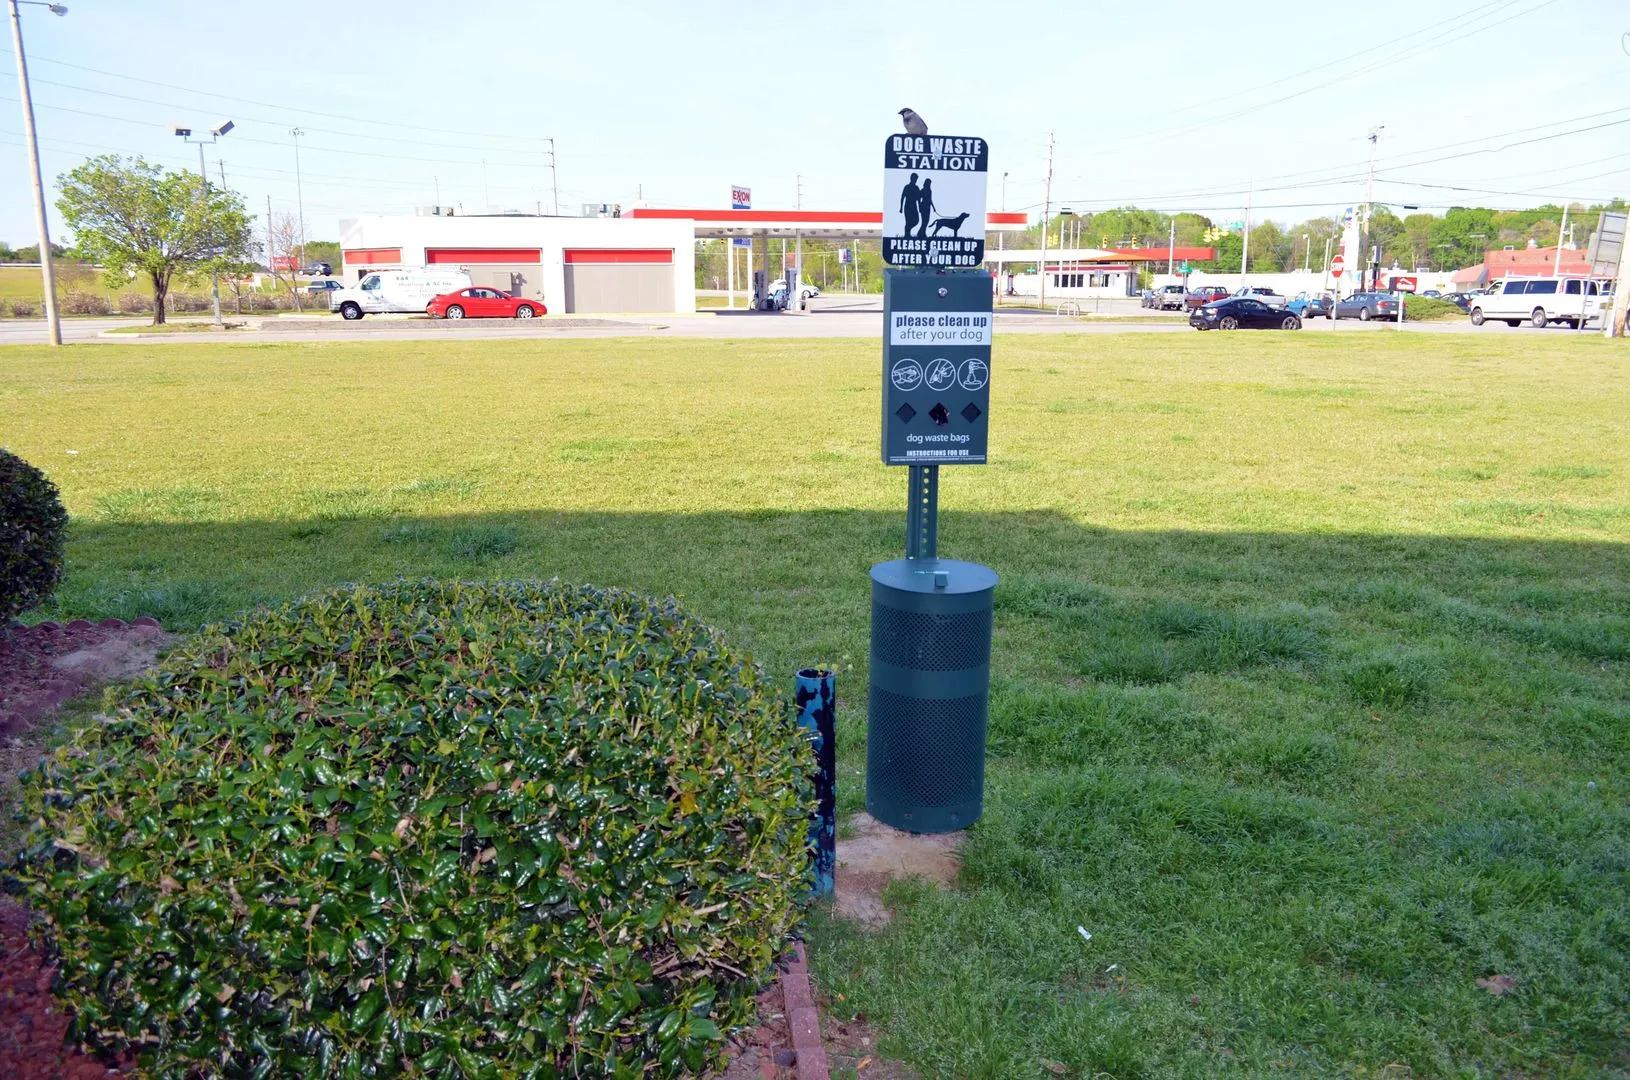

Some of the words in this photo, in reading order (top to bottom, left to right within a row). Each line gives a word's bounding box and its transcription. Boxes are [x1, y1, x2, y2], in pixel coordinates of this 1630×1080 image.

[893, 136, 924, 153] DOG
[929, 138, 982, 155] WASTE
[898, 155, 976, 171] STATION
[732, 190, 750, 204] EXXON
[890, 239, 927, 251] PLEASE
[929, 240, 961, 252] CLEAN
[964, 241, 978, 252] UP
[891, 253, 923, 265] AFTER
[925, 254, 952, 265] YOUR
[954, 254, 976, 266] DOG
[896, 315, 936, 328] please
[938, 315, 970, 327] clean
[973, 316, 988, 328] up
[900, 327, 928, 340] after
[930, 330, 957, 342] your
[959, 328, 983, 342] dog
[906, 433, 924, 444] dog
[924, 434, 949, 442] waste
[950, 432, 970, 443] bags
